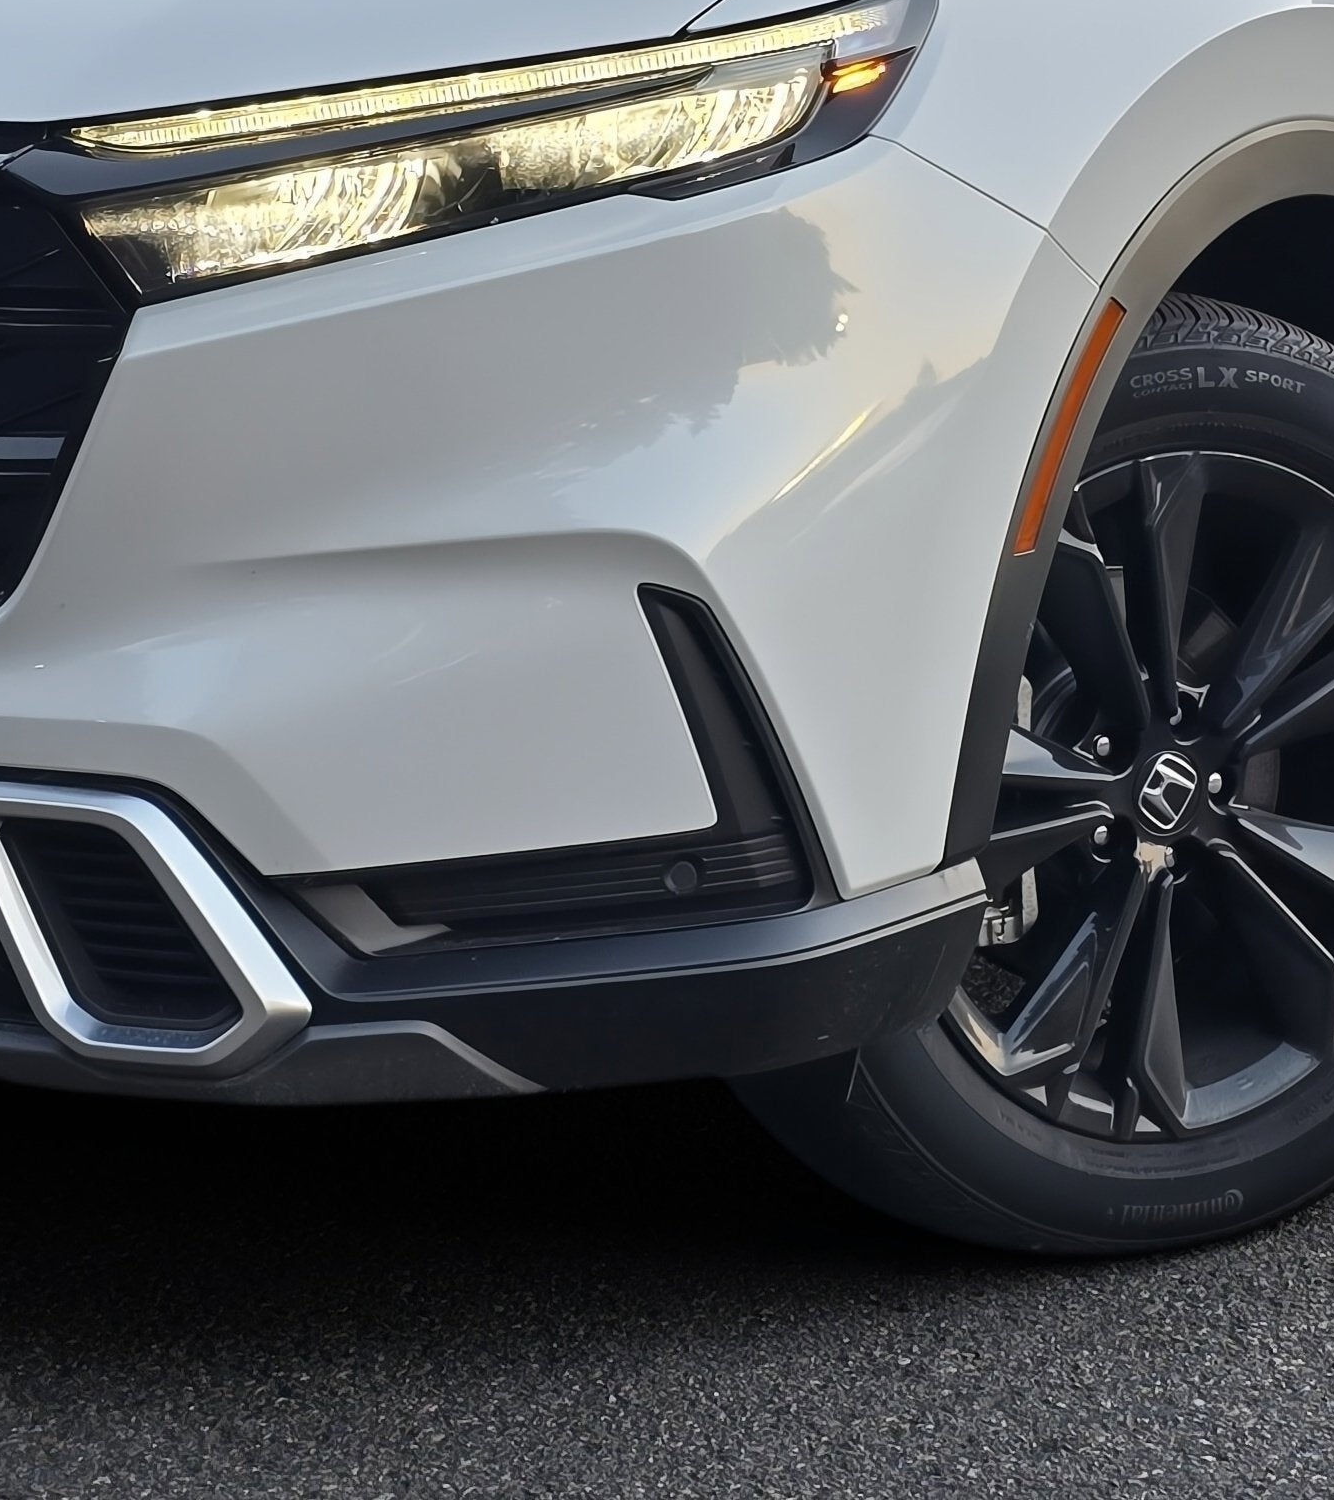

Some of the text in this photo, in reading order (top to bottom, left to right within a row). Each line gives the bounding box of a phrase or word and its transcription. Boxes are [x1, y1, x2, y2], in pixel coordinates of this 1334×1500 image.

[1129, 366, 1306, 394] CROSS LX SPORT
